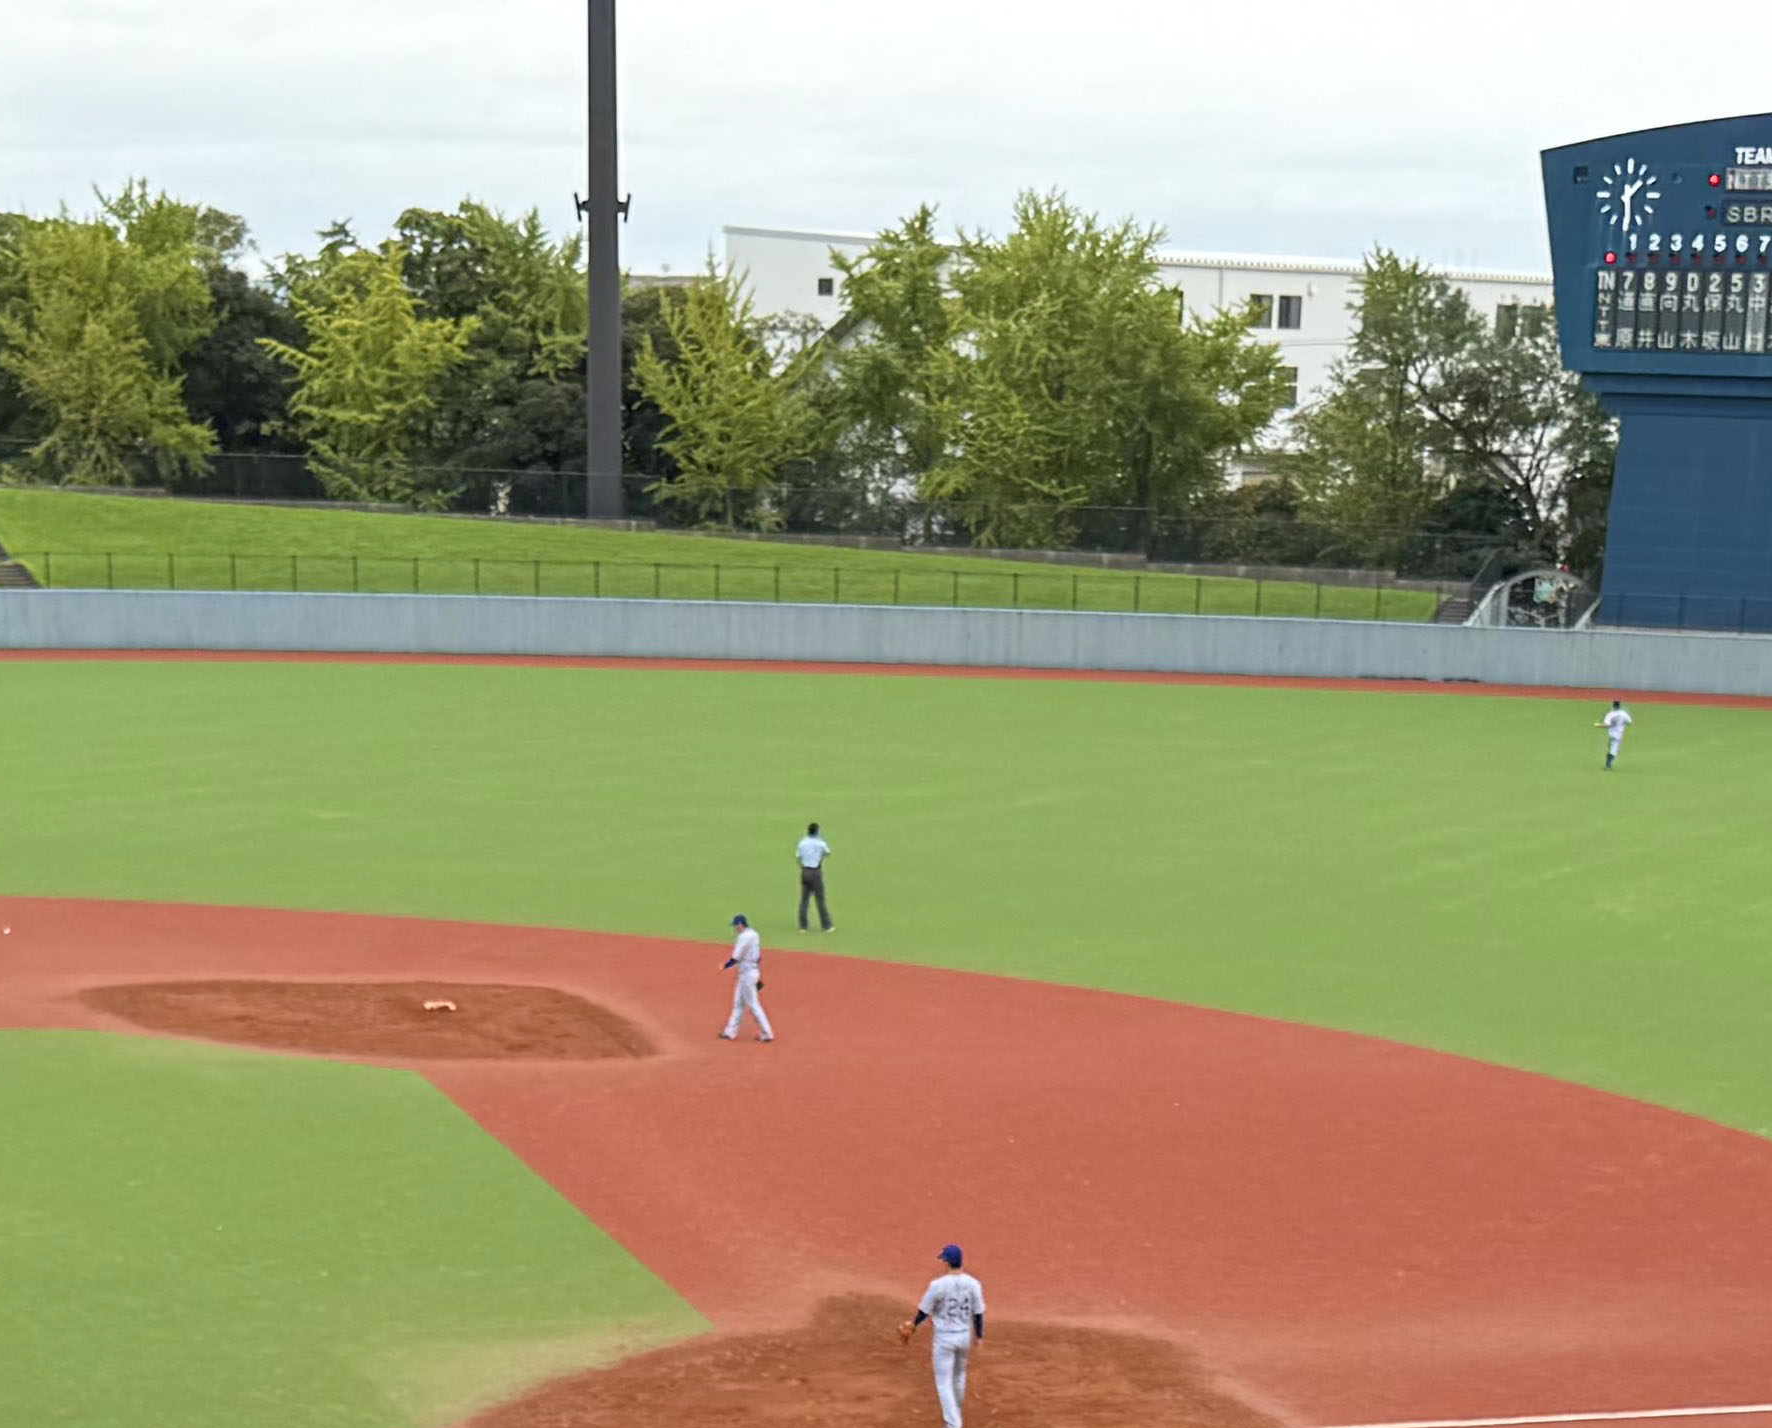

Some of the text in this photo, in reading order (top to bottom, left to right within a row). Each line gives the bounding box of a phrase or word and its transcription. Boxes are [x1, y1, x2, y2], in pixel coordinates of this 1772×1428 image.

[1629, 234, 1637, 250] 1
[1649, 234, 1661, 251] 2
[1671, 234, 1682, 251] 3
[1692, 234, 1704, 251] 4
[1715, 234, 1726, 252] 5
[1736, 235, 1749, 252] 6
[1759, 236, 1771, 252] 7
[1623, 272, 1634, 290] 7
[1644, 272, 1655, 290] 8
[1665, 273, 1677, 290] 9
[1709, 274, 1721, 292] 2
[1731, 274, 1743, 293] 5
[1753, 274, 1765, 293] 3
